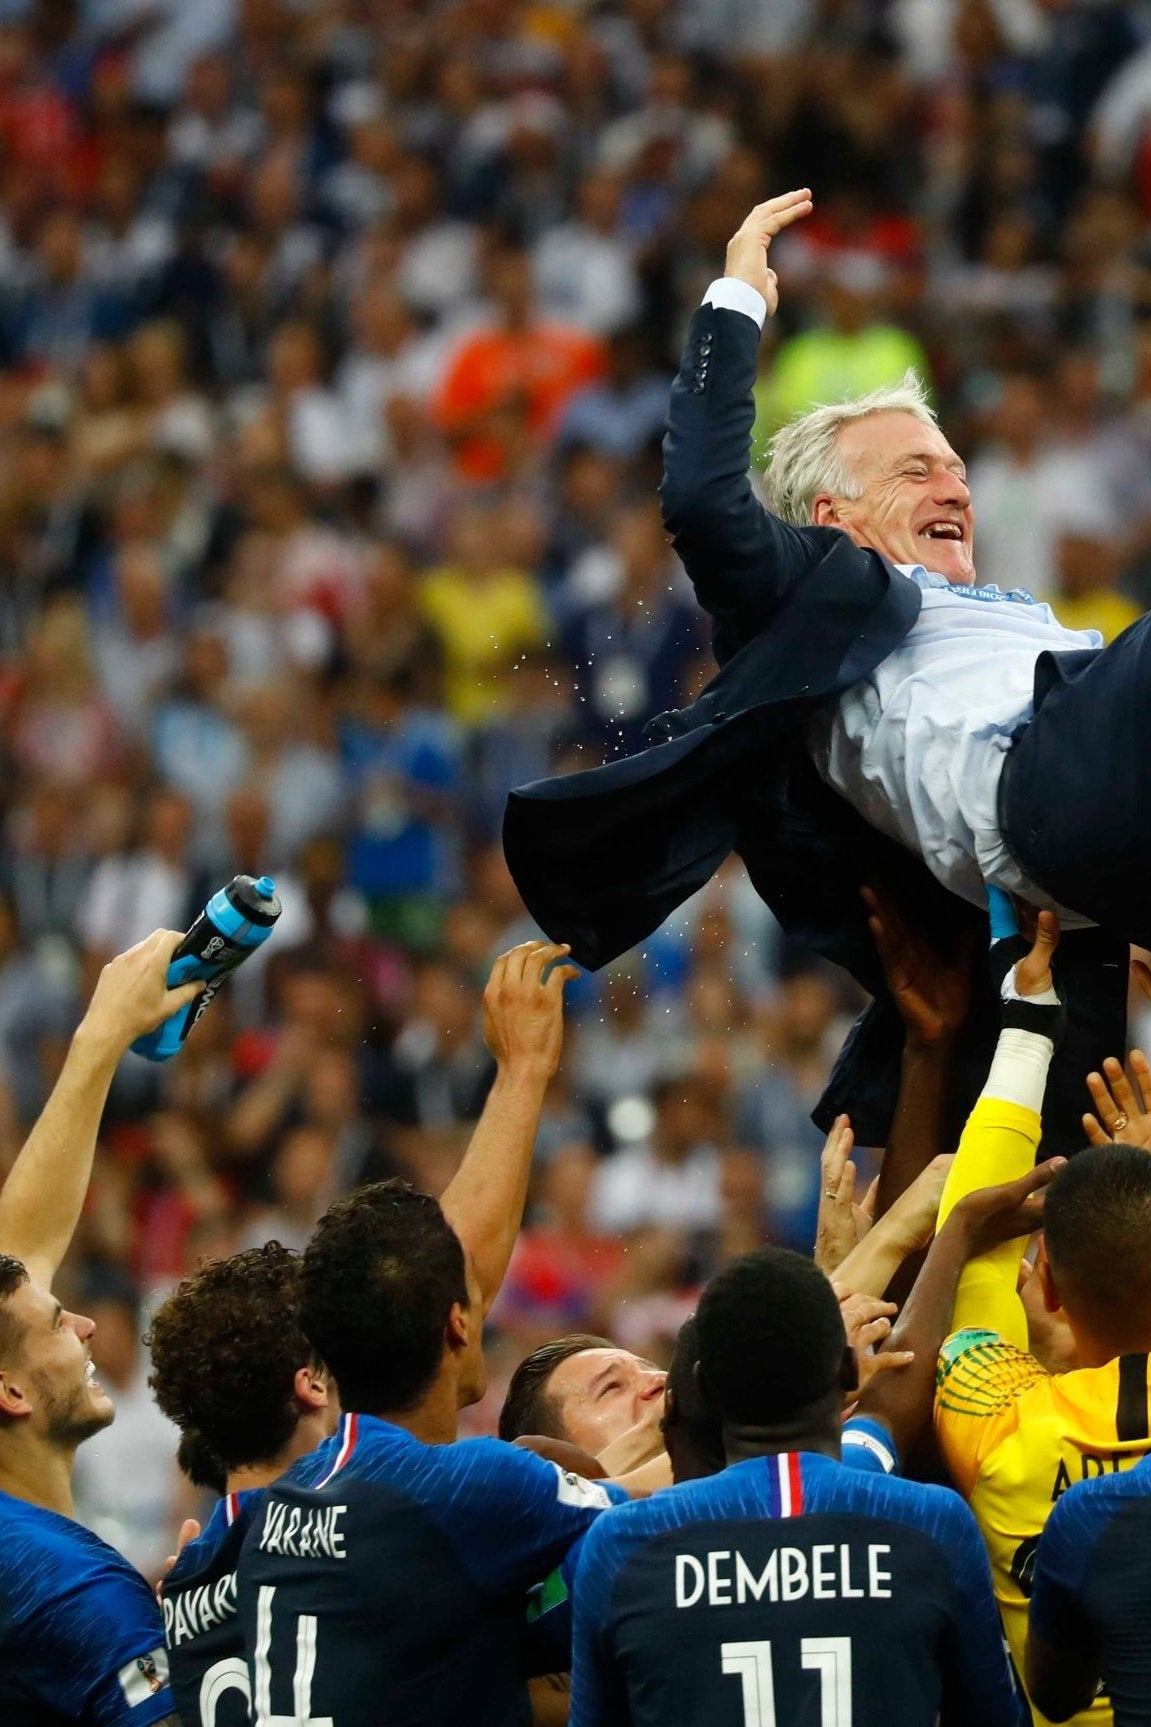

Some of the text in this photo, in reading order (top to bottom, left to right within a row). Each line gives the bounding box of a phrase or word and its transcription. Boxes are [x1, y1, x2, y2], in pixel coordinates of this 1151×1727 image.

[259, 1501, 348, 1559] VARANE
[675, 1543, 893, 1609] DEMBELE
[254, 1585, 334, 1727] 4
